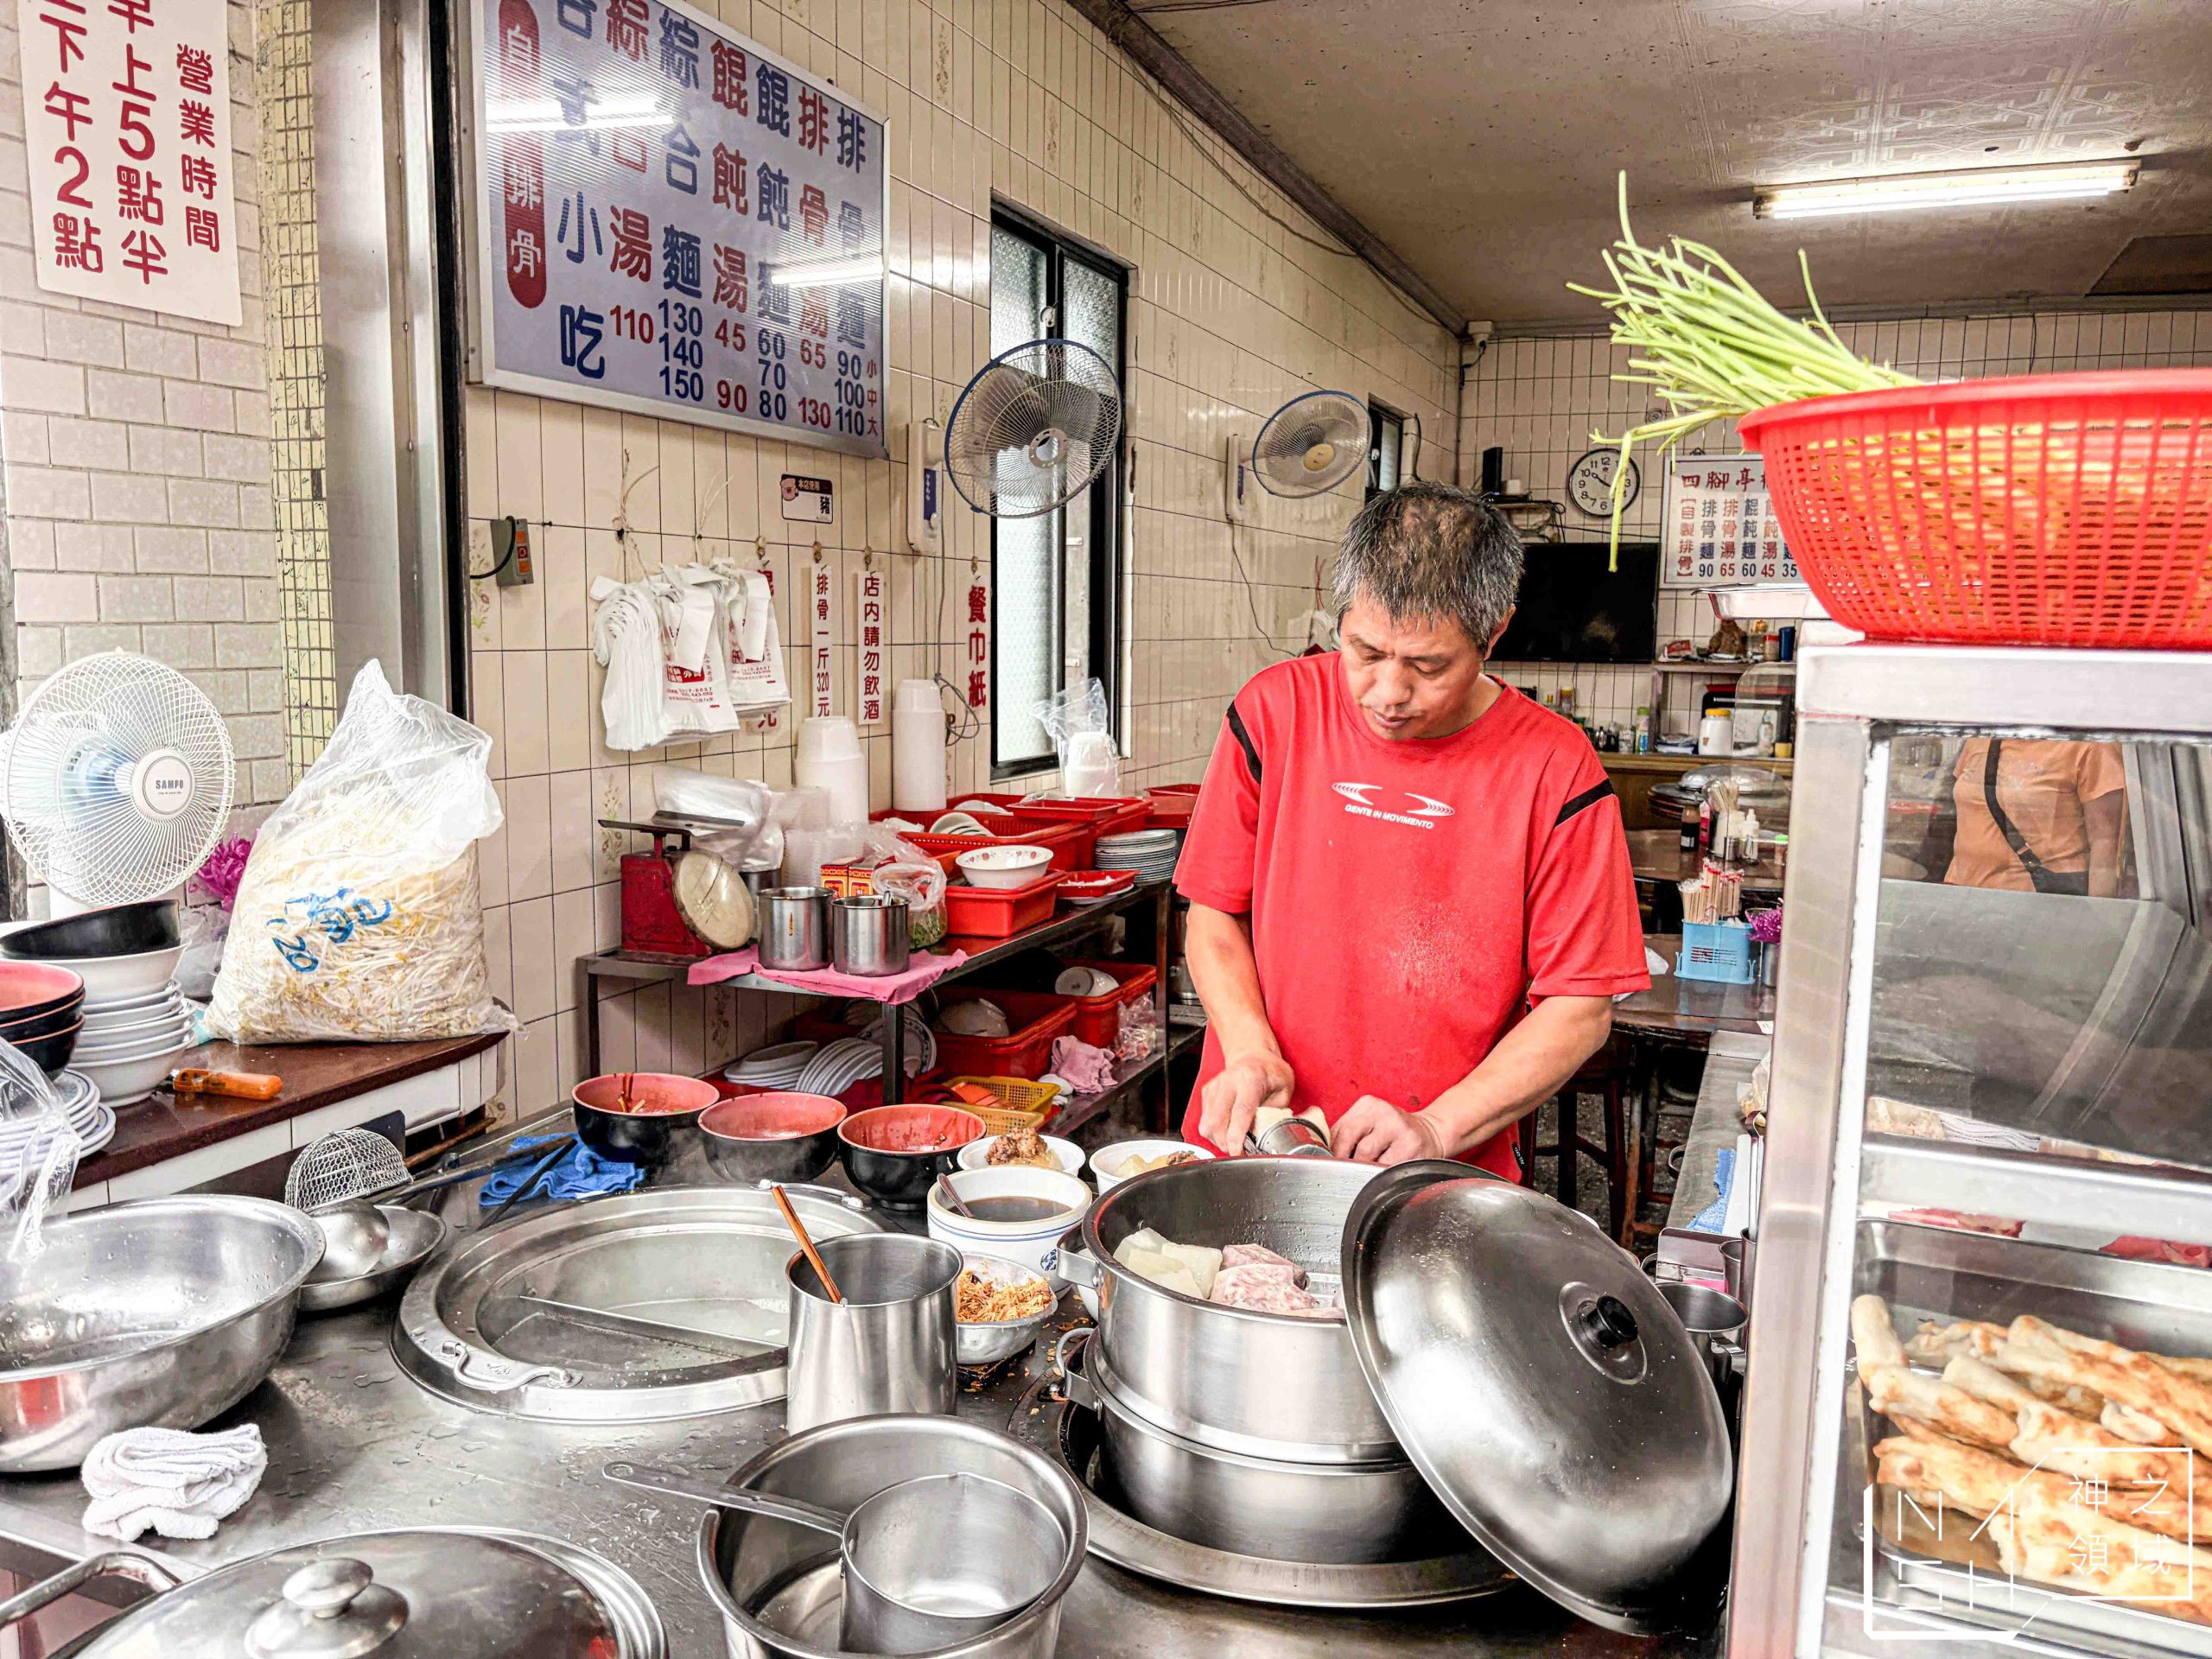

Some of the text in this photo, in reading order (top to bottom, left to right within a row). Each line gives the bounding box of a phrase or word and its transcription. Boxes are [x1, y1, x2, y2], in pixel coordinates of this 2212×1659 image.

[39, 0, 104, 274] 下午2點
[176, 43, 220, 253] 營業時間
[505, 25, 543, 279] 自排骨
[658, 9, 704, 402] 綜合麵 130 140 150
[710, 39, 748, 413] 餛飩湯 45 90
[755, 63, 790, 421] 餛飩麵 60 70 80
[798, 86, 831, 429] 排骨湯 65 130
[834, 107, 867, 436] 排骨麵 90 100 110
[610, 305, 654, 345] 110
[867, 359, 879, 436] 小 中 大
[1578, 480, 1586, 489] 9
[1580, 468, 1591, 478] 10
[1580, 490, 1589, 500] 8
[1590, 460, 1599, 469] 11
[1600, 456, 1611, 466] 12
[1624, 479, 1631, 488] 3
[1681, 467, 1767, 493] 四腳亭
[1599, 500, 1608, 511] 6
[1699, 499, 1717, 578] 排骨麵 90
[1719, 499, 1738, 577] 排骨湯 65
[1740, 499, 1758, 577] 餛飩麵 60
[1760, 563, 1776, 578] 45
[1782, 563, 1798, 578] 35
[817, 573, 830, 717] 排骨一斤320元
[863, 576, 880, 721] 店內請勿飲酒
[968, 584, 987, 707] 餐巾紙
[156, 779, 184, 790] SAMPO
[1372, 810, 1382, 818] IN
[1382, 812, 1434, 830] MOVIMENTO
